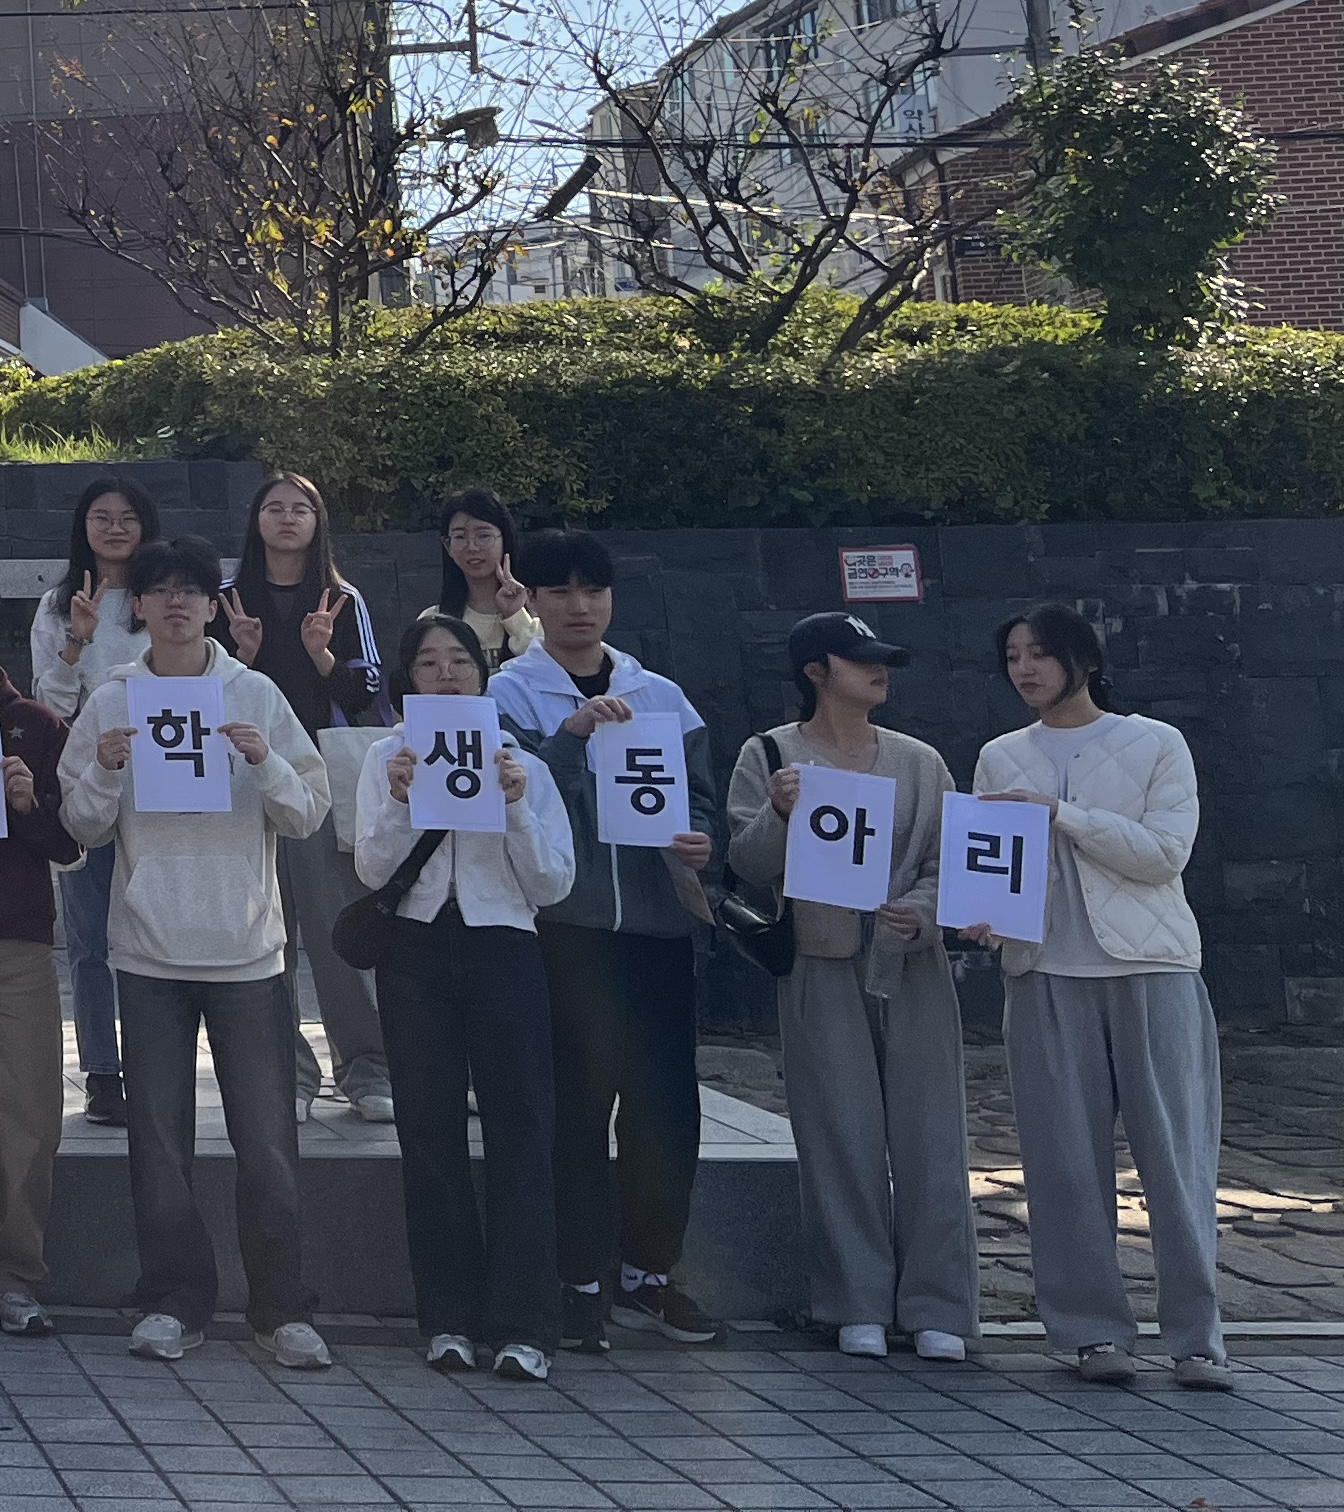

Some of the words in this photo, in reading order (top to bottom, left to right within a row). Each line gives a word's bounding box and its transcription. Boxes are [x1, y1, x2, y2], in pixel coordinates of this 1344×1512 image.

[147, 709, 210, 777] 학
[424, 731, 482, 798] 생
[615, 748, 675, 815] 동
[810, 806, 875, 865] 아
[967, 832, 1023, 894] 리
